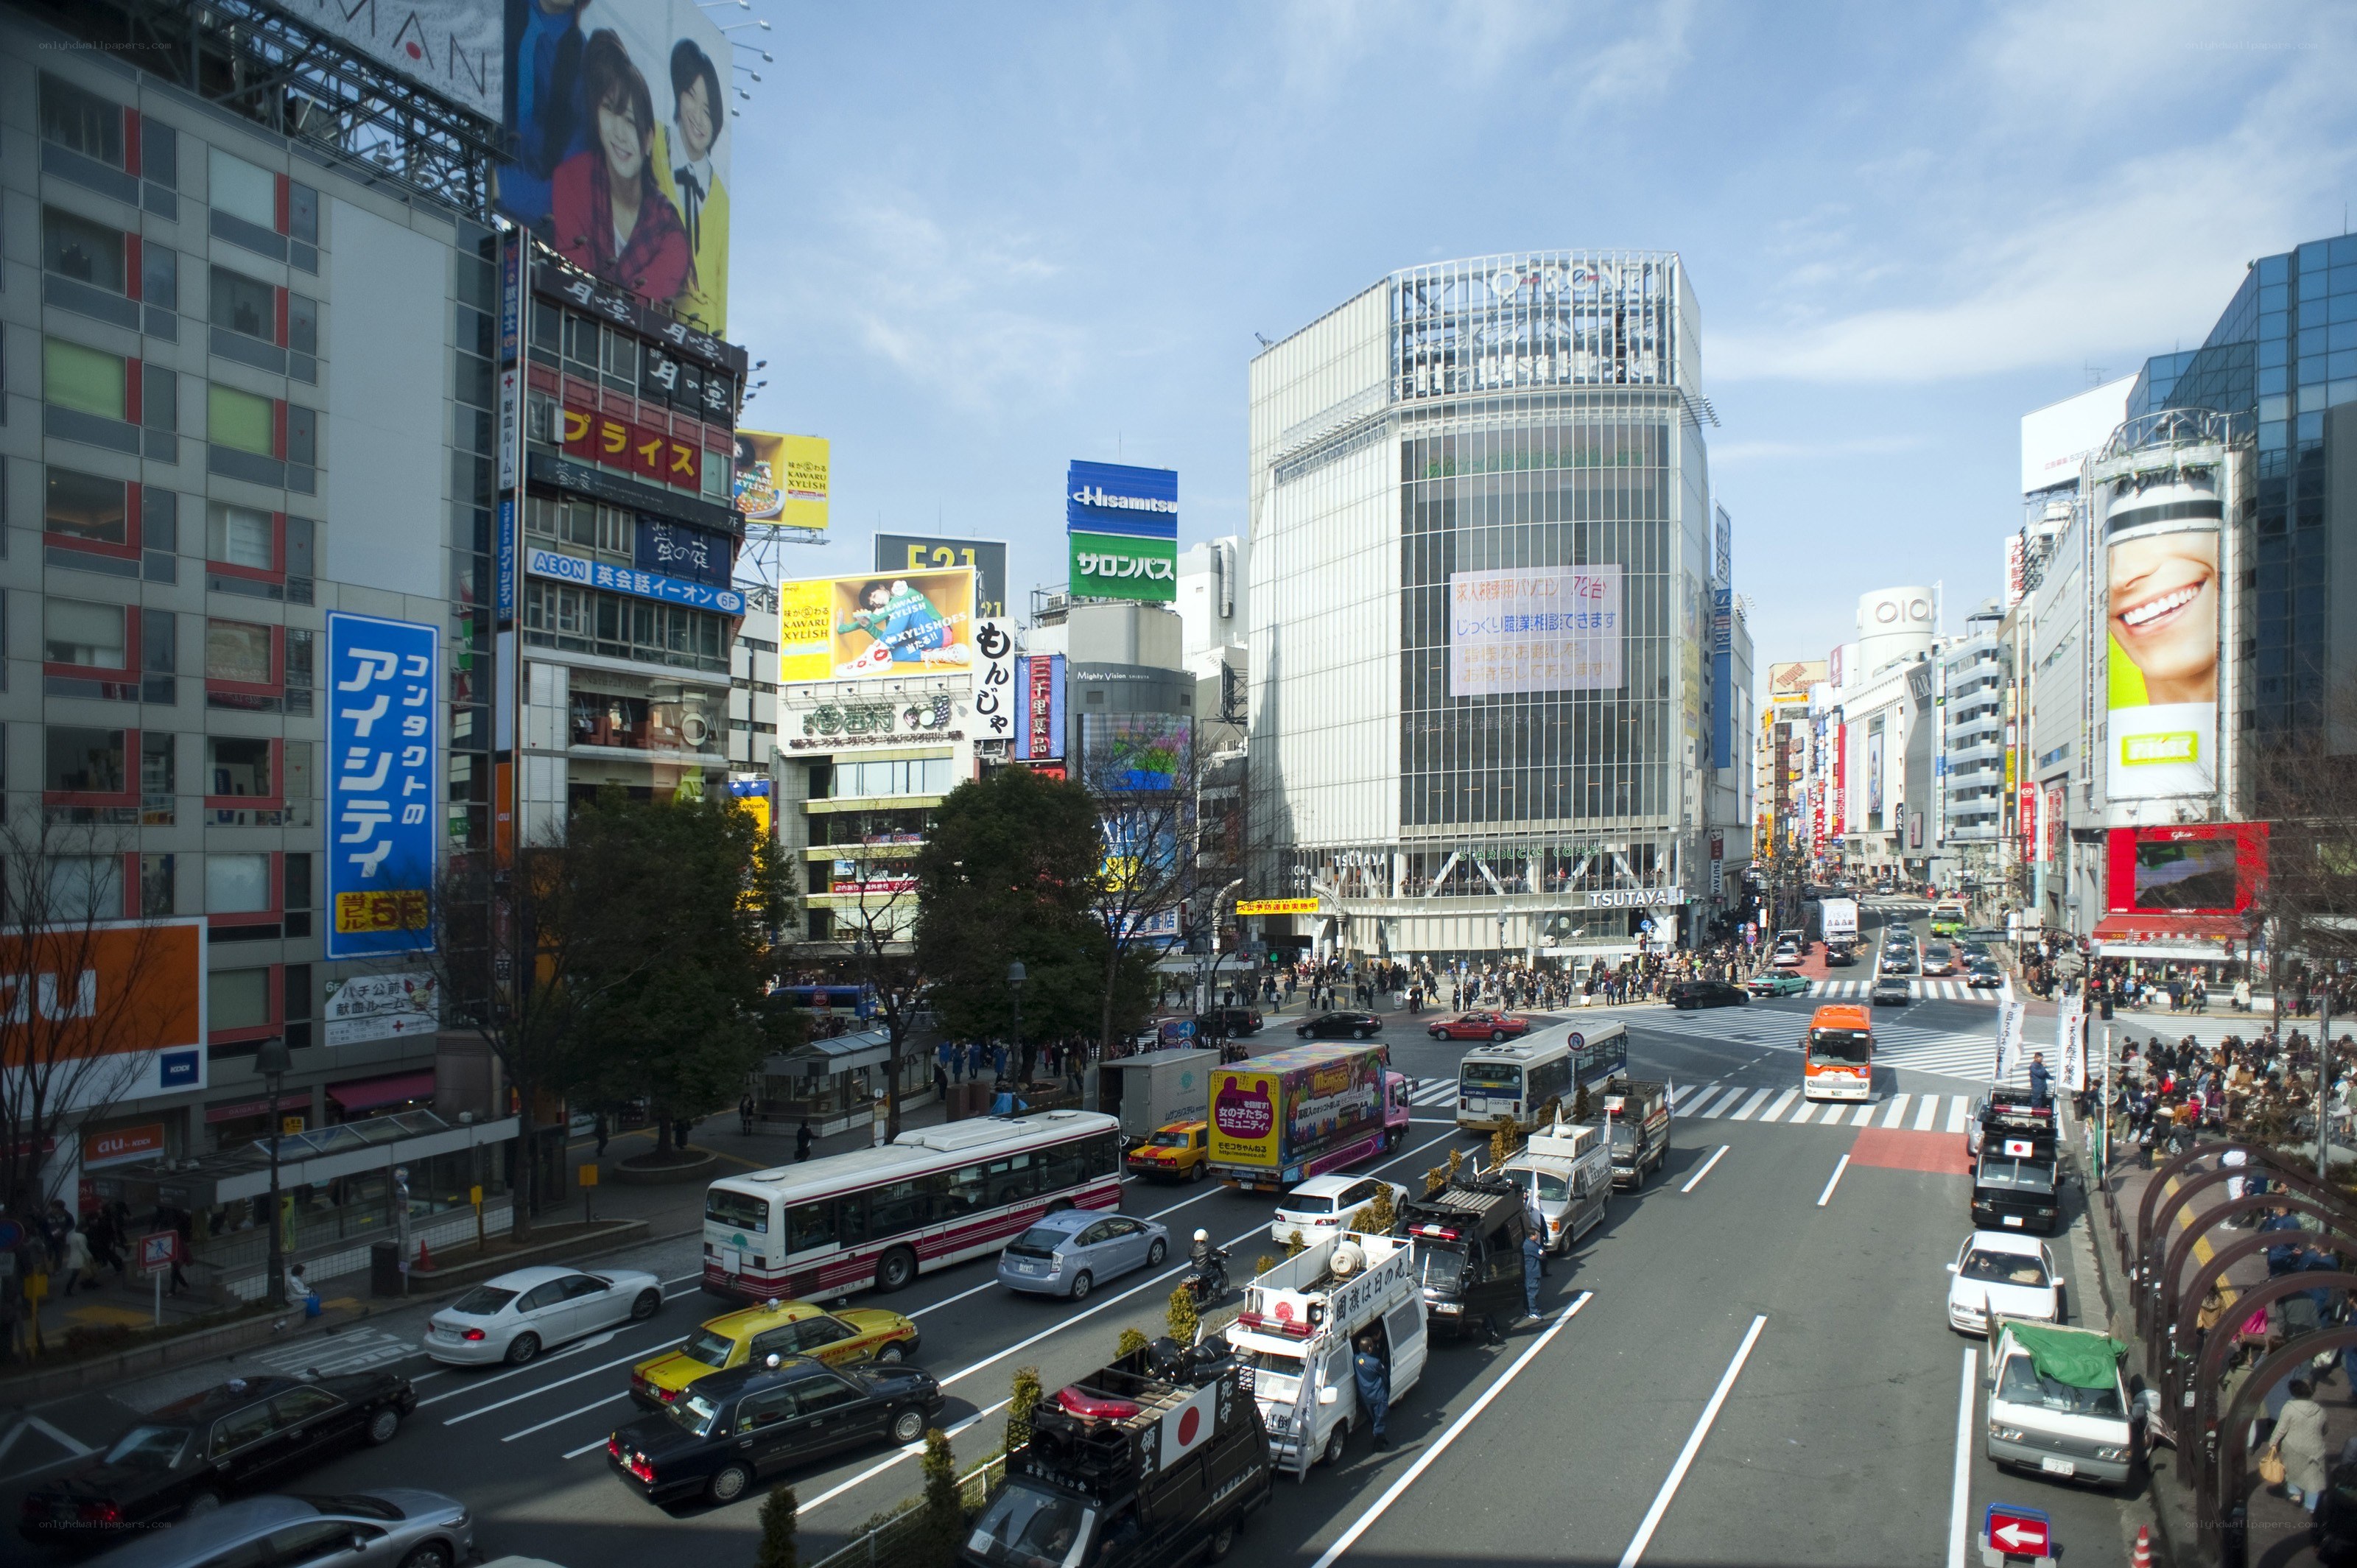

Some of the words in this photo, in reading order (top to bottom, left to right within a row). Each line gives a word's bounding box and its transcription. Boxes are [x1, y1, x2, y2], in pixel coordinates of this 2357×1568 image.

[650, 348, 663, 359] 9F
[502, 398, 513, 475] 献血ルーム
[564, 409, 695, 477] プライス
[736, 470, 773, 487] KAWARU
[787, 471, 826, 482] KAWARU
[1072, 485, 1178, 513] Hisamitsu
[728, 516, 739, 527] 7F
[534, 552, 586, 580] AEON
[1077, 552, 1174, 581] サロンパス
[499, 546, 513, 605] アイシティ
[597, 565, 712, 605] 英会話イーオン
[784, 585, 799, 593] meiji
[721, 595, 737, 608] 6F
[885, 593, 924, 612] KAWARU
[499, 606, 512, 619] 5F
[784, 618, 829, 629] KAWARU
[1457, 611, 1617, 636] じっくり職業相談できます
[1715, 594, 1731, 655] SEIBU
[976, 622, 1011, 734] もんじゃ
[1077, 671, 1104, 681] Mighty
[1104, 672, 1126, 681] Vision
[1031, 659, 1047, 753] 三千里薬品
[1404, 712, 1553, 736] 身元はまだ確認されず
[402, 654, 429, 825] コンタクトの
[337, 647, 399, 878] アイシティ
[2171, 830, 2196, 839] Glico
[1334, 851, 1385, 867] TSUTAYA
[1458, 848, 1544, 862] STARBUCKS
[1590, 890, 1666, 908] TSUTAYA
[371, 895, 425, 927] 5F
[325, 981, 341, 993] 6F
[342, 982, 400, 999] ハチ公前
[336, 998, 404, 1017] 献血ルーム
[169, 1064, 190, 1074] KDDI
[1165, 1105, 1195, 1120] ムゲンシステム
[1219, 1108, 1269, 1120] 女の子たちの
[1219, 1118, 1269, 1131] コミュニティ。
[97, 1138, 123, 1153] au
[132, 1137, 151, 1147] KDDI
[1218, 1142, 1267, 1153] モモコちゃんねる
[1014, 1198, 1046, 1212] ノンステップバス
[1220, 1379, 1233, 1424] 死守
[1139, 1426, 1156, 1480] 領土
